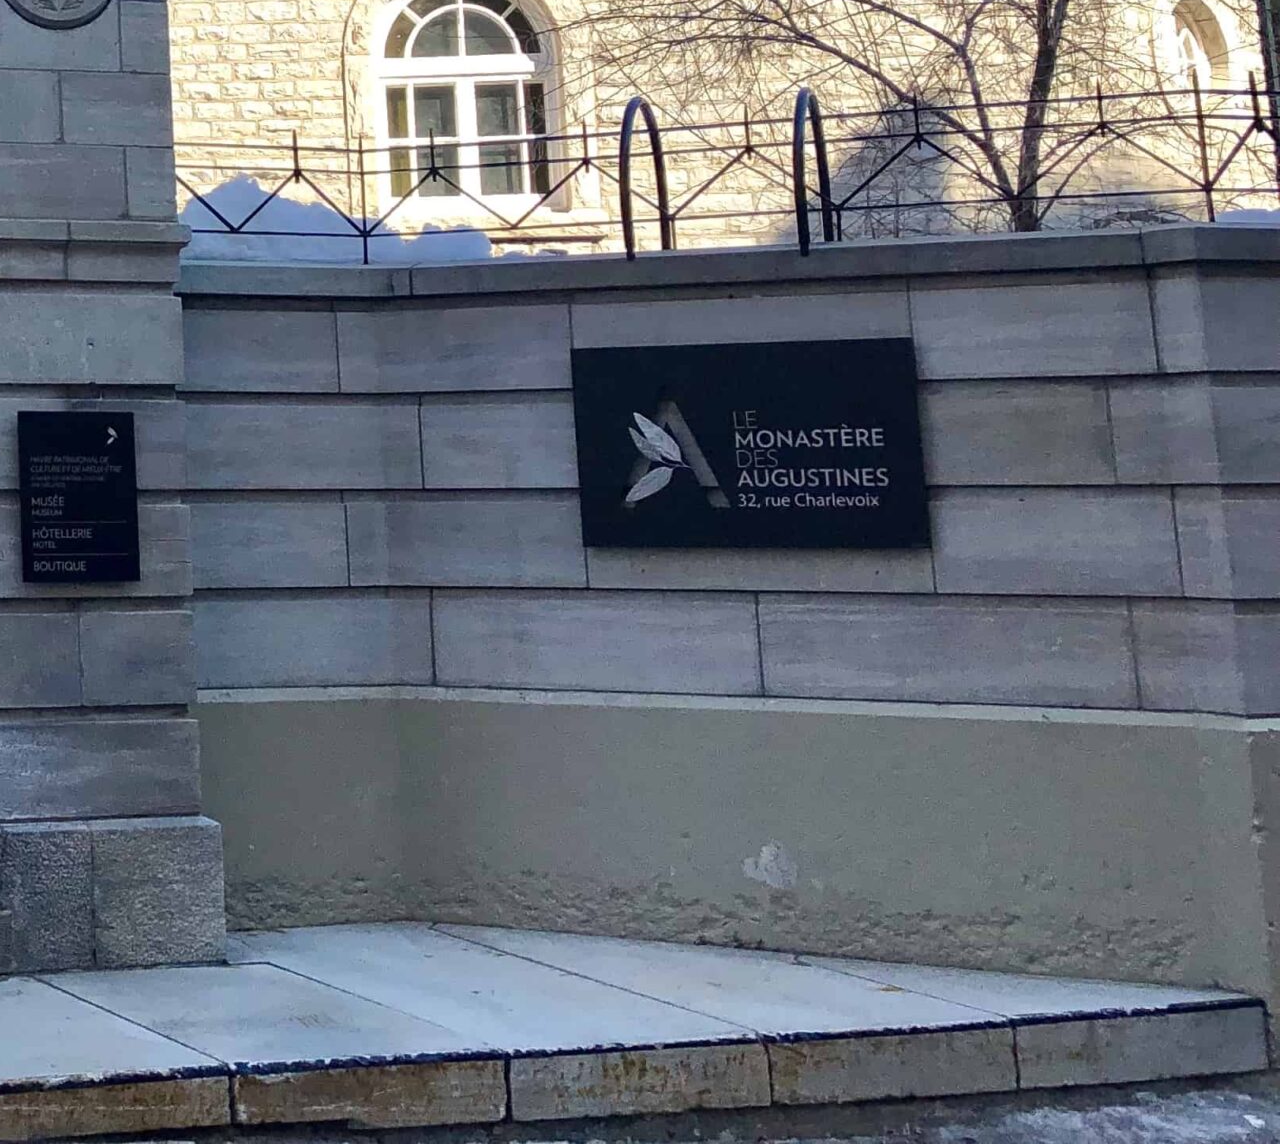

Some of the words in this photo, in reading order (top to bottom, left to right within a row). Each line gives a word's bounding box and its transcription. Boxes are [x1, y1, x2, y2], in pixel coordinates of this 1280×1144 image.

[733, 410, 757, 429] LE
[734, 424, 885, 449] MONASTÈRE
[736, 449, 779, 468] DES
[737, 468, 889, 488] AUGUSTINES
[31, 494, 64, 506] MUSÉE
[737, 493, 762, 509] 32,
[765, 495, 791, 507] rue
[795, 492, 880, 508] Charlevoix
[32, 526, 92, 539] HÔTELLERIE
[33, 560, 87, 572] BOUTIQUE
